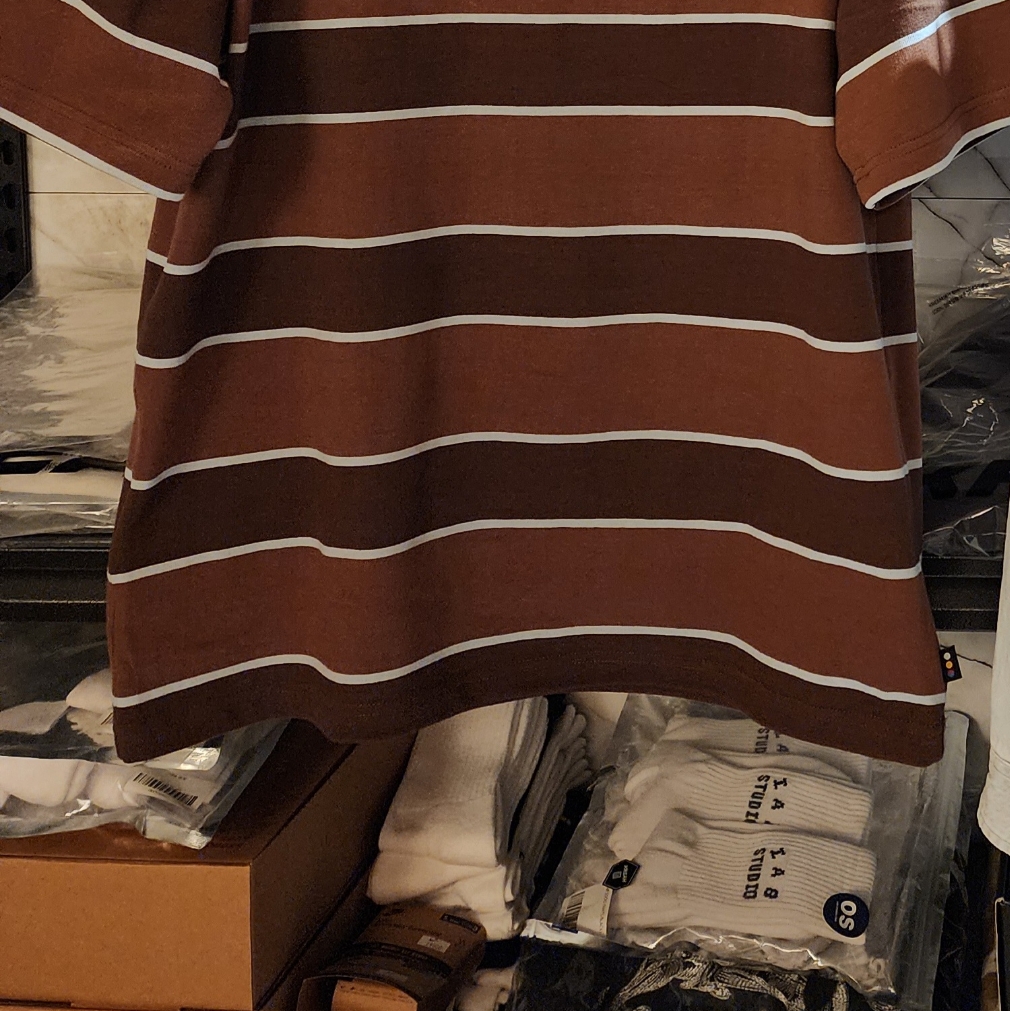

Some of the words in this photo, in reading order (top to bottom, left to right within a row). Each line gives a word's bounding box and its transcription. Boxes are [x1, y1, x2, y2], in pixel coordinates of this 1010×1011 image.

[743, 774, 771, 824] STUDI
[742, 847, 766, 900] STUDIO
[838, 900, 857, 931] OS
